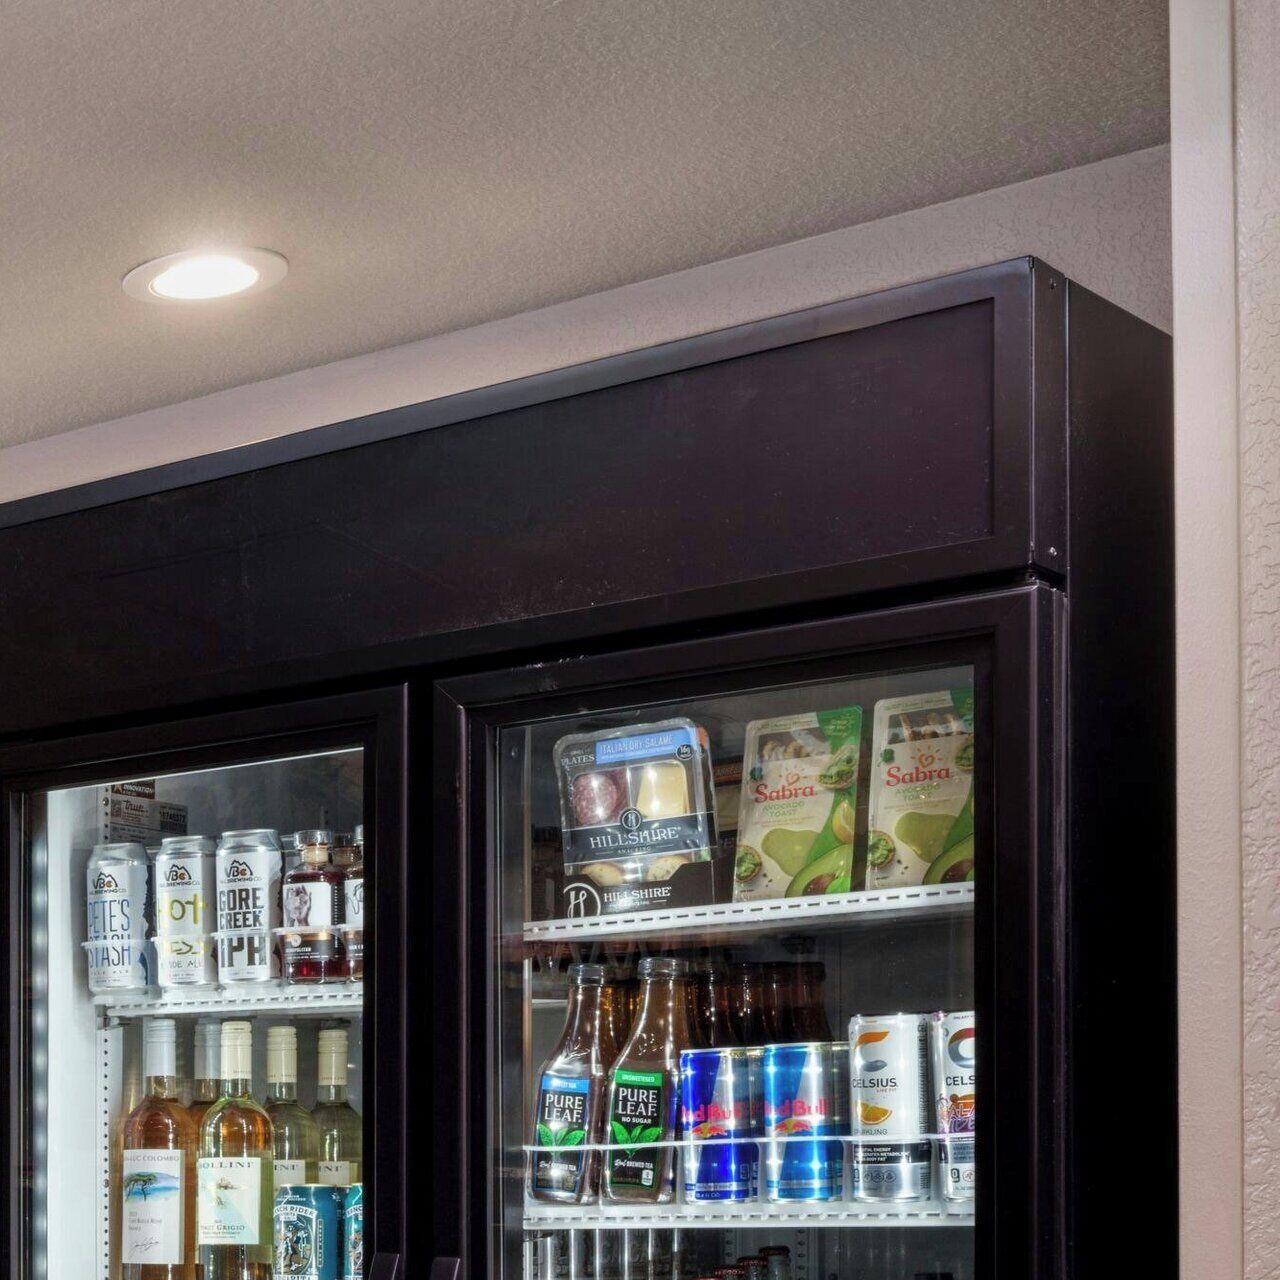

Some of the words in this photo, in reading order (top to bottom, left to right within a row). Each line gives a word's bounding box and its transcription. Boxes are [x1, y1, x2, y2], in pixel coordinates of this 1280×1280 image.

[561, 754, 595, 766] PLATES
[885, 766, 950, 786] Sabra
[753, 784, 815, 803] Sabra
[590, 827, 681, 848] HILLSHIRE
[604, 887, 671, 902] HILLSHIRE
[852, 1077, 897, 1088] CELSIUS
[545, 1094, 583, 1109] PURE
[619, 1088, 658, 1103] PURE
